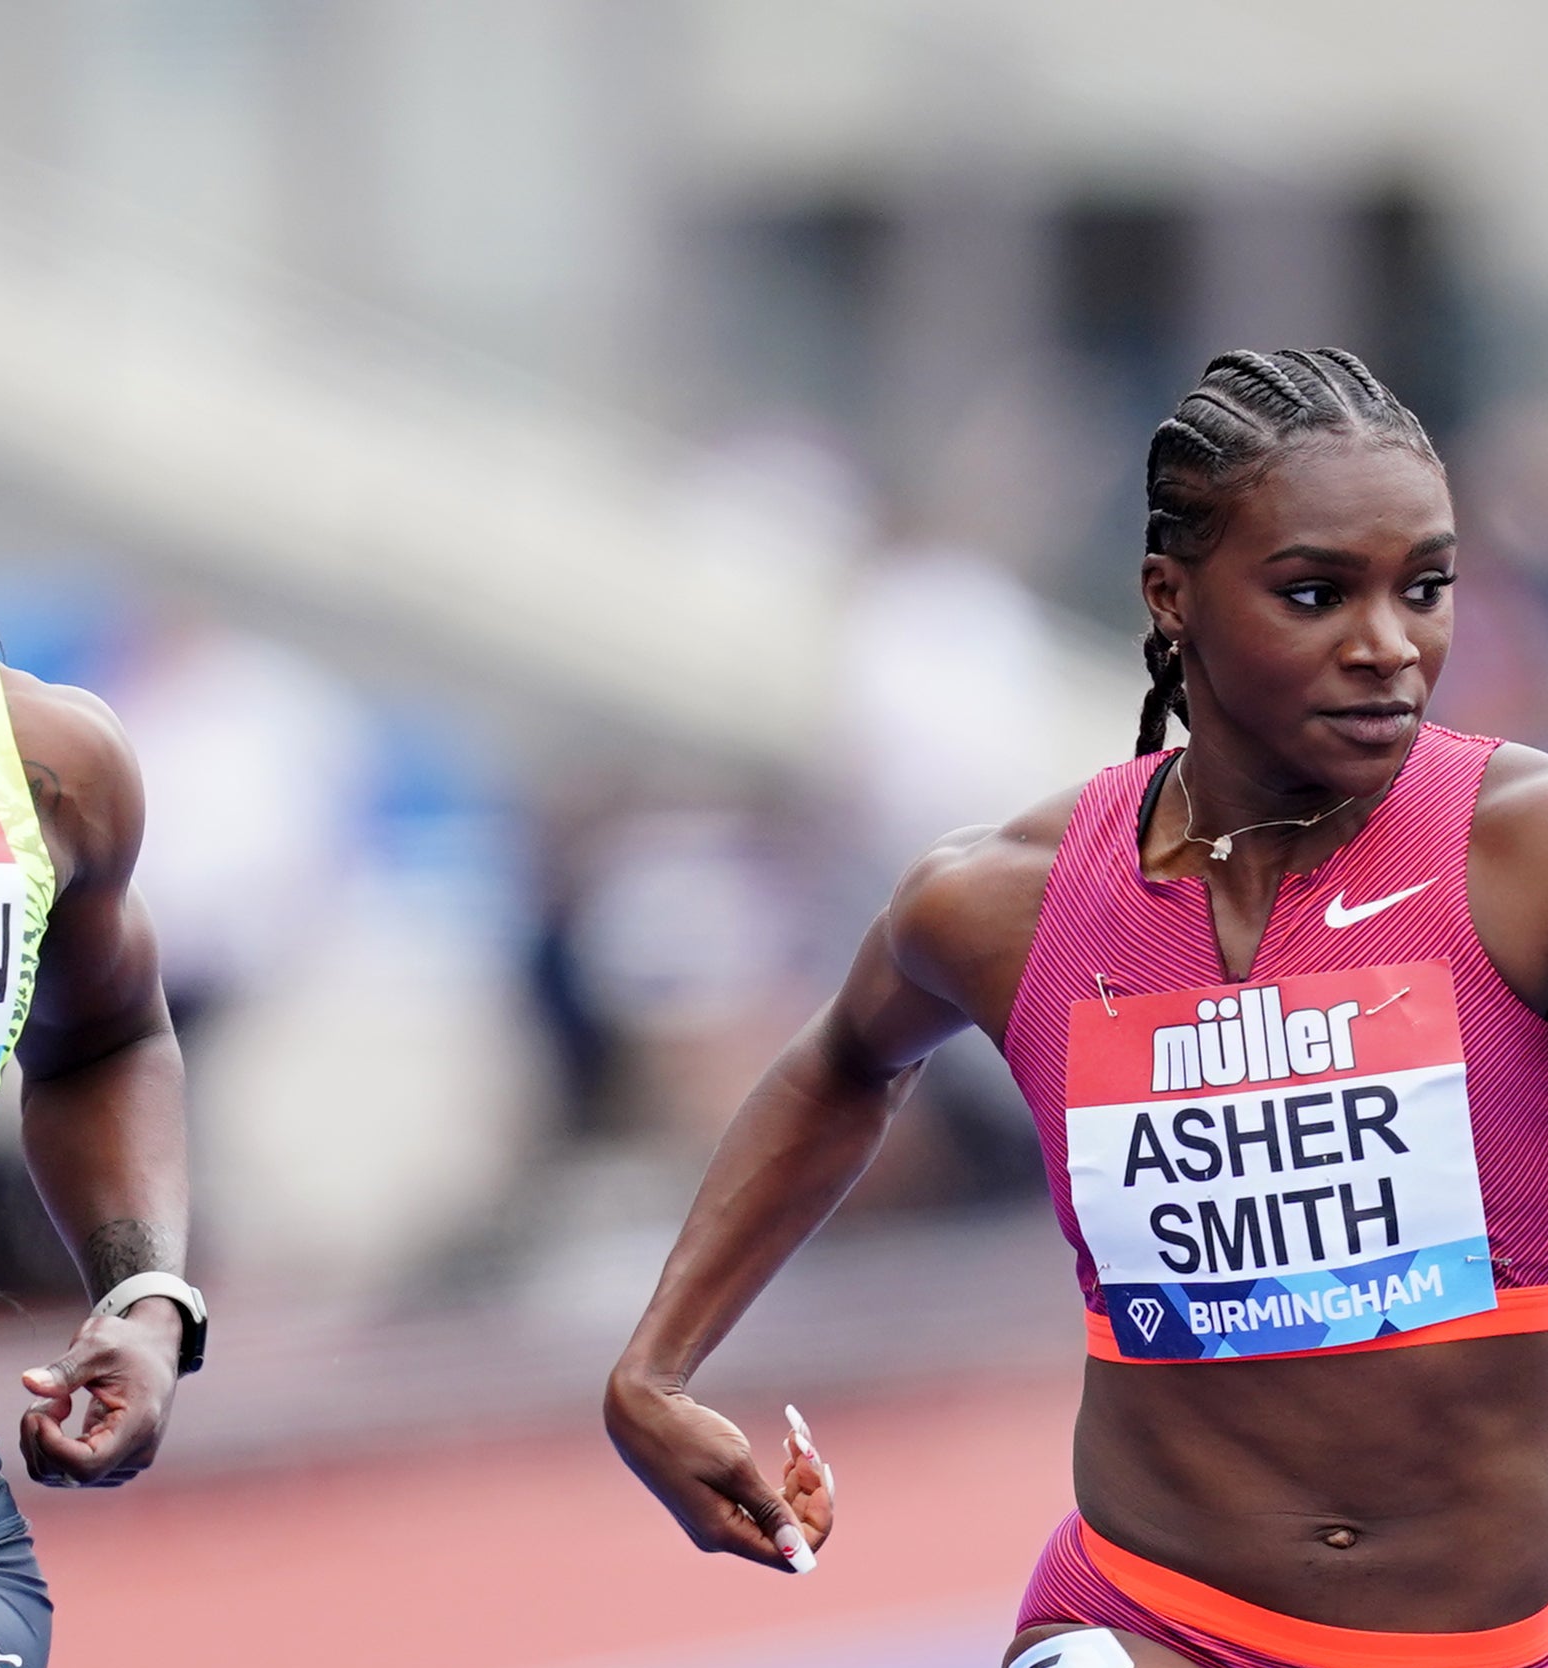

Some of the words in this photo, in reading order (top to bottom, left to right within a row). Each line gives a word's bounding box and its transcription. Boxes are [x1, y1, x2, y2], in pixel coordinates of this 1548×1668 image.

[1151, 985, 1360, 1093] müller
[1123, 1085, 1410, 1187] ASHER
[1150, 1177, 1400, 1275] SMITH
[1189, 1265, 1444, 1335] BIRMINGHAM
